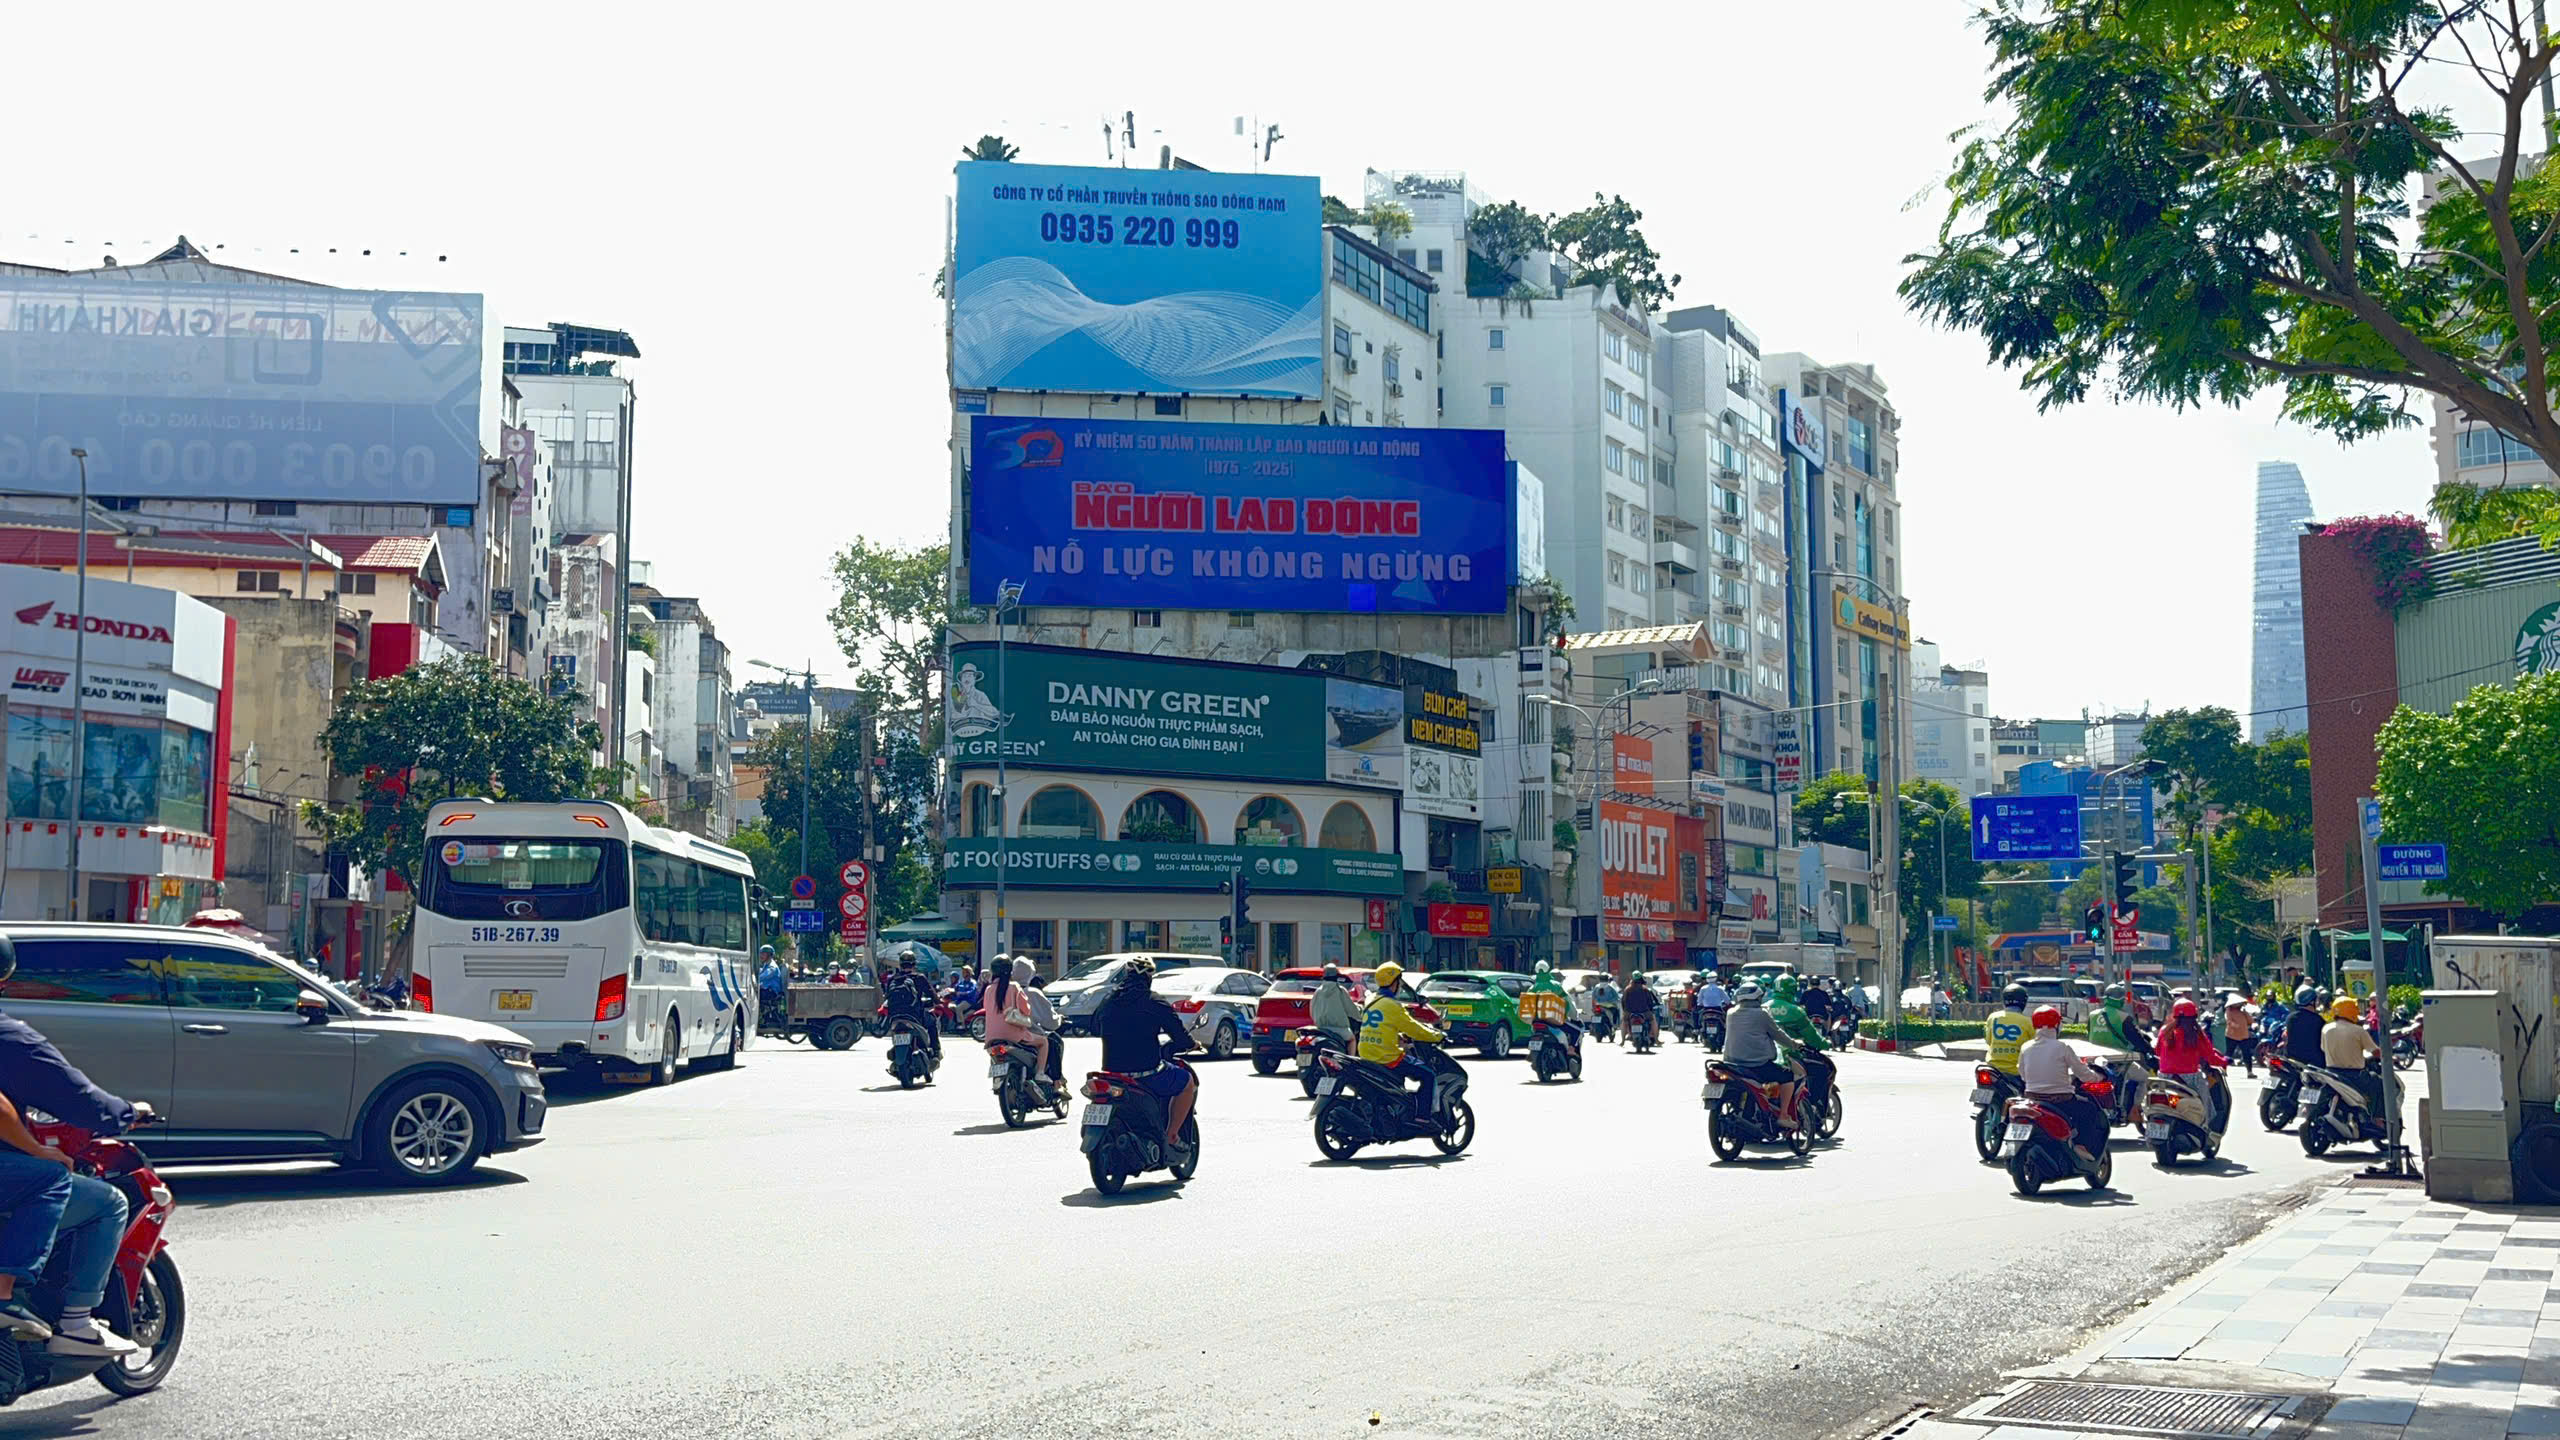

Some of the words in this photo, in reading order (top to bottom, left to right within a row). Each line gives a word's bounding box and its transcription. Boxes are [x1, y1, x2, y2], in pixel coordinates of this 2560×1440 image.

[993, 184, 1026, 200] CÔNG
[1030, 187, 1044, 200] TY
[1103, 187, 1147, 206] TRUYỀN
[1152, 190, 1190, 207] THÔNG
[1194, 193, 1218, 208] SAO
[1222, 194, 1254, 210] ĐÔNG
[1258, 197, 1286, 212] NAM
[1041, 212, 1114, 244] 0935
[1123, 215, 1174, 247] 220
[1185, 218, 1239, 249] 999
[1138, 435, 1156, 449] 50
[1353, 440, 1378, 456] LAO
[1213, 496, 1297, 533] LAO
[1303, 495, 1420, 537] ĐỘNG
[1103, 544, 1175, 580] LỰC
[1193, 546, 1323, 578] KHÔNG
[1343, 550, 1470, 581] NGỪNG
[54, 612, 174, 644] HONDA
[81, 687, 107, 698] EAD
[1048, 681, 1156, 710] DANNY
[1157, 717, 1190, 734] THỰC
[1412, 718, 1433, 743] NEM
[1434, 723, 1455, 746] CUA
[1777, 730, 1796, 740] NHA
[1073, 730, 1090, 743] AN
[1094, 730, 1128, 745] TOÀN
[1130, 734, 1157, 748] CHO
[1160, 737, 1180, 750] GIA
[1183, 735, 1210, 751] ĐÌNH
[1214, 740, 1238, 754] BẠN
[1776, 742, 1800, 752] KHOA
[1728, 801, 1747, 827] NHA
[1749, 806, 1773, 832] KHOA
[1600, 818, 1667, 876] OUTLET
[2393, 848, 2432, 859] ĐƯỜNG
[964, 851, 1091, 870] FOODSTUFFS
[1623, 891, 1649, 919] 50%
[472, 927, 560, 942] 51B-267.39
[1993, 1018, 2022, 1041] be
